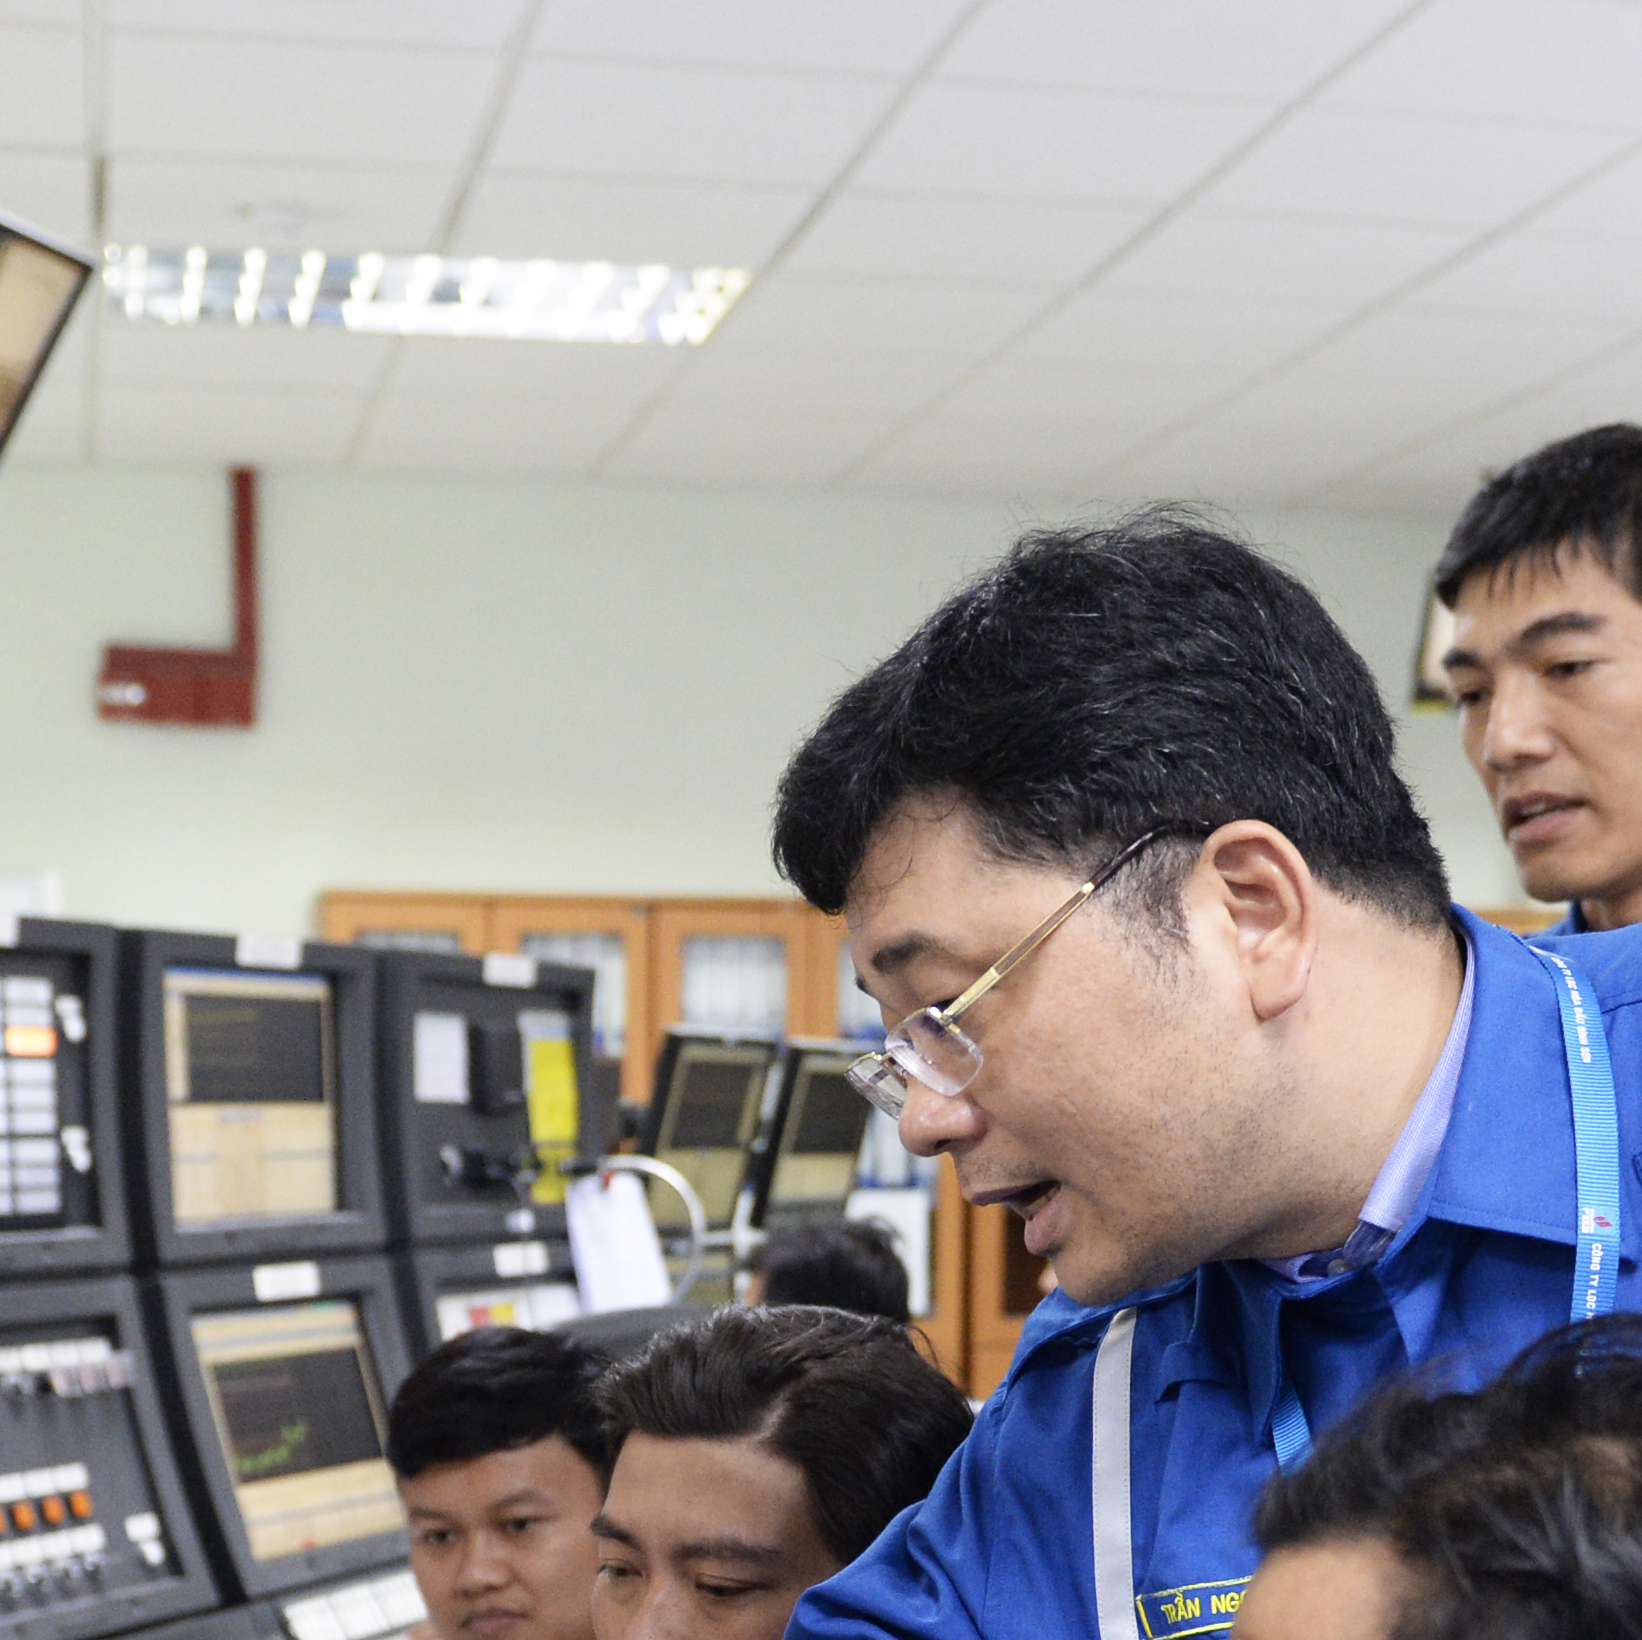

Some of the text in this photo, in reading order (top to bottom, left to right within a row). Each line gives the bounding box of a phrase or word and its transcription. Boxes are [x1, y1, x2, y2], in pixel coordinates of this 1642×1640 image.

[1590, 1243, 1603, 1271] CÔNG
[1589, 1274, 1599, 1287] TY
[1585, 1289, 1597, 1309] LỌC
[1160, 1589, 1247, 1624] TRẦN NG
